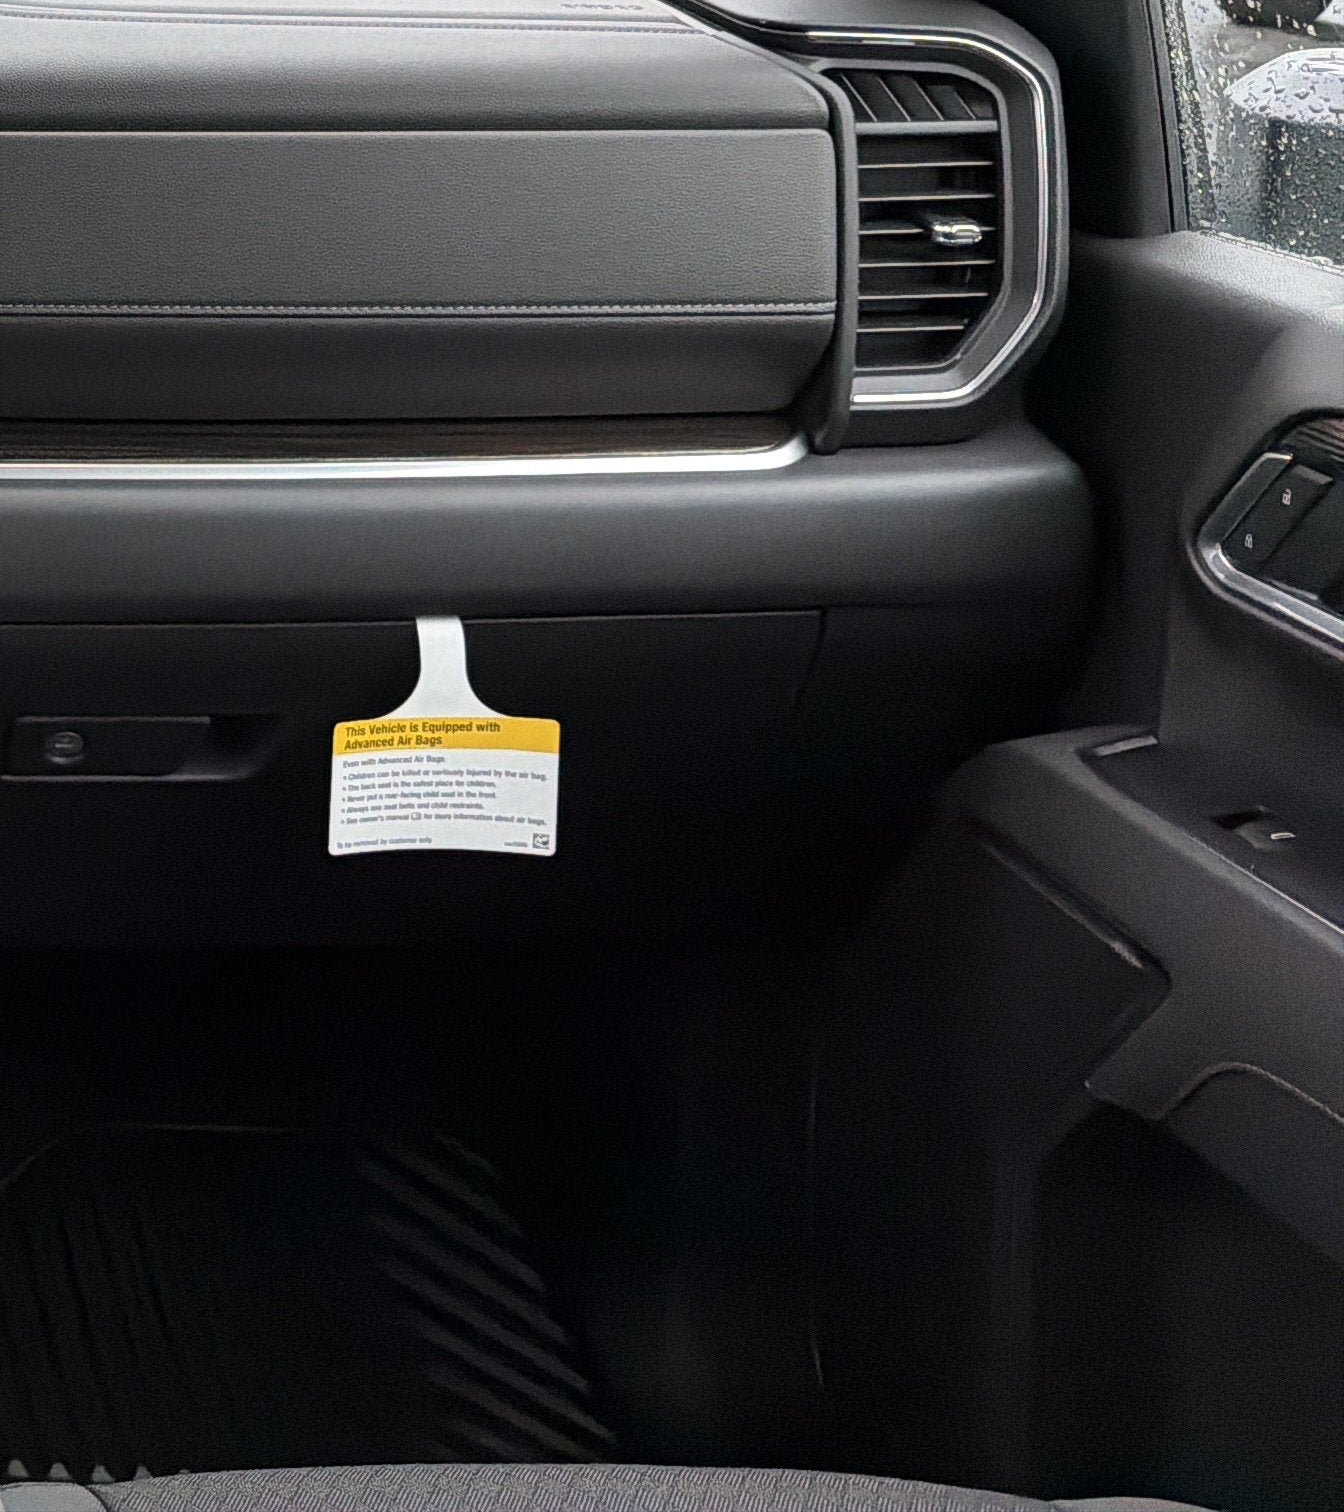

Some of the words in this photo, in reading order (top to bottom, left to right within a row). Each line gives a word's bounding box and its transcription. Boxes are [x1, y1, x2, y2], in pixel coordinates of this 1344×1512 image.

[345, 726, 366, 737] This
[369, 723, 406, 735] Vehicle
[422, 722, 473, 735] Equipped
[475, 722, 501, 733] with
[344, 737, 394, 751] Advanced
[397, 735, 413, 746] Air
[415, 734, 443, 747] Bags
